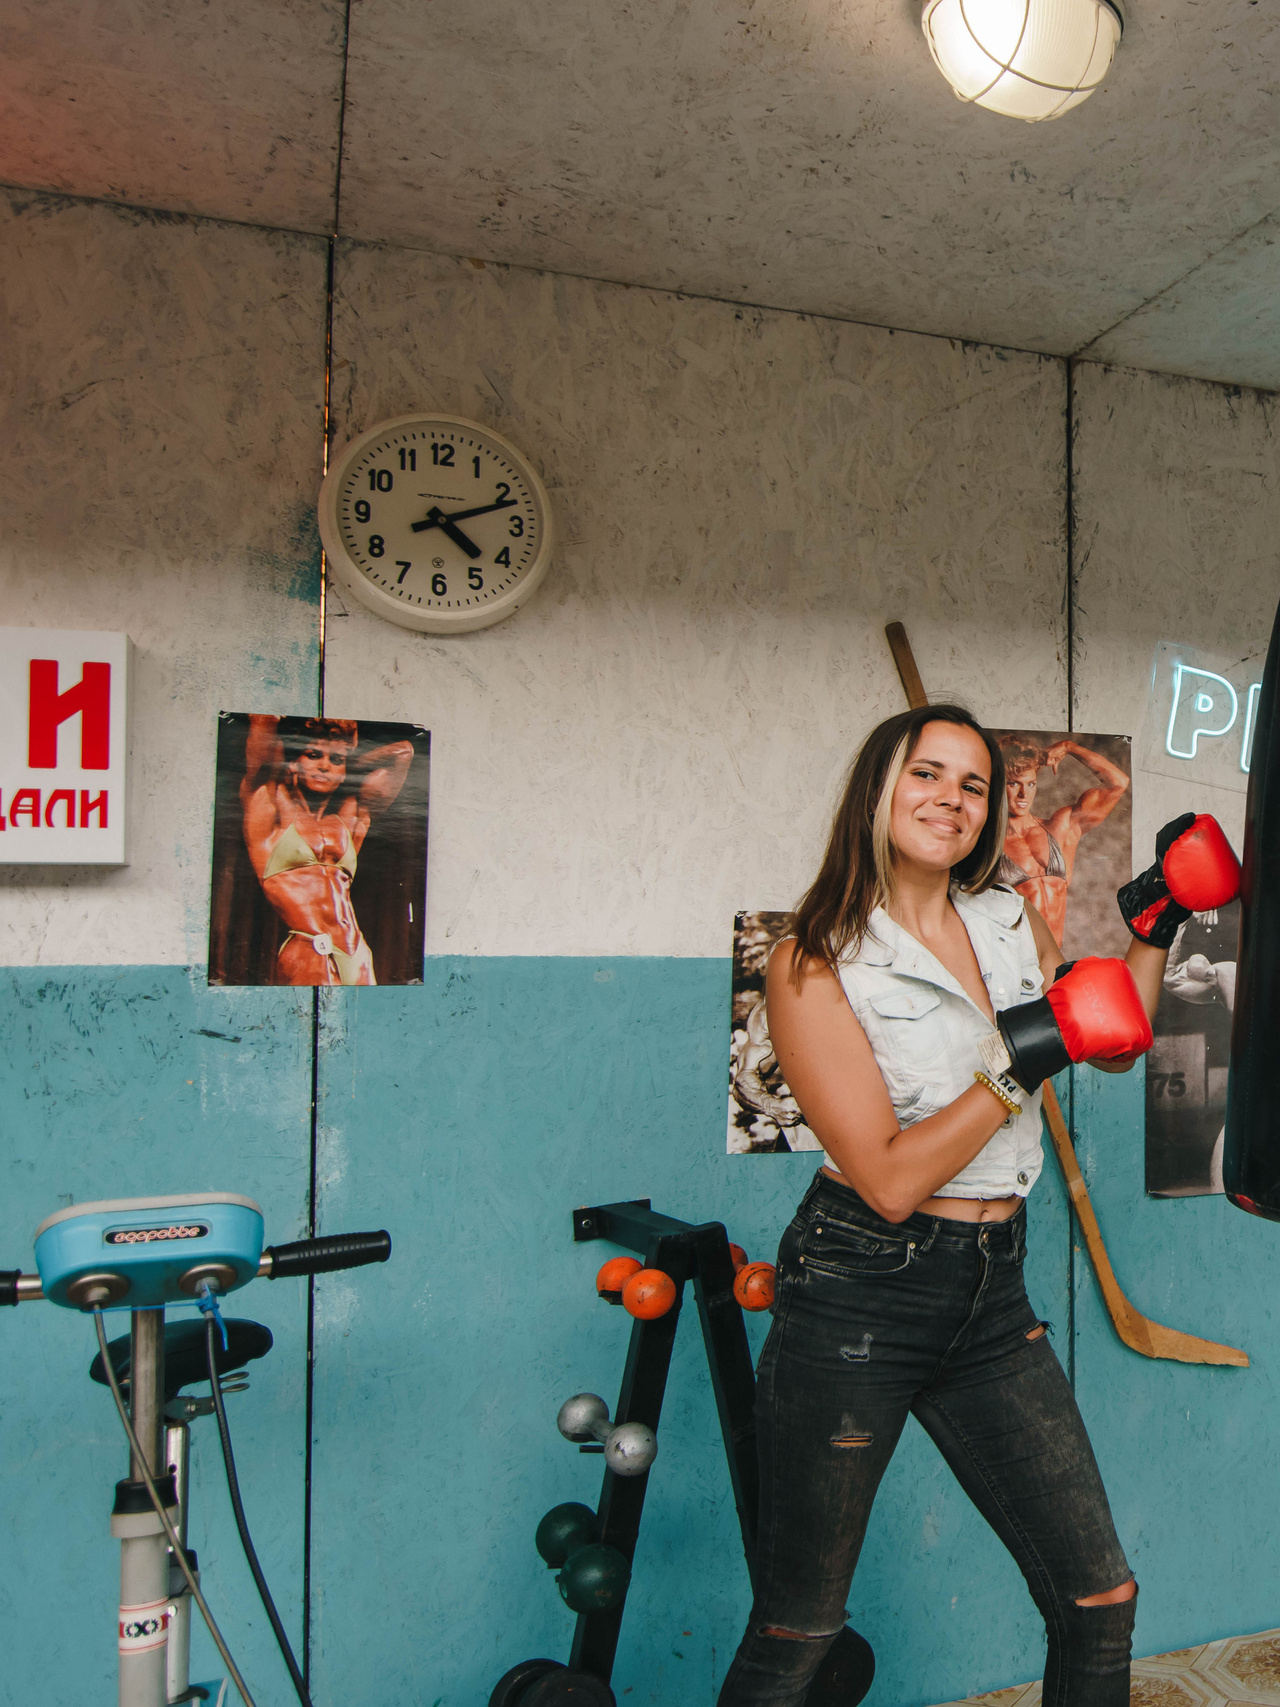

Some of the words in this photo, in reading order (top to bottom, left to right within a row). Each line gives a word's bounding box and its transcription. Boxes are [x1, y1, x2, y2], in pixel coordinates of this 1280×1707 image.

[398, 448, 416, 471] 11
[431, 442, 455, 467] 12
[472, 456, 481, 478] 1
[368, 468, 393, 492] 10
[495, 482, 511, 505] 2
[354, 500, 371, 523] 9
[509, 515, 524, 537] 3
[368, 535, 385, 558] 8
[494, 546, 511, 568] 4
[395, 561, 411, 584] 7
[468, 567, 483, 590] 5
[431, 573, 447, 596] 6
[0, 787, 109, 832] АЛИ
